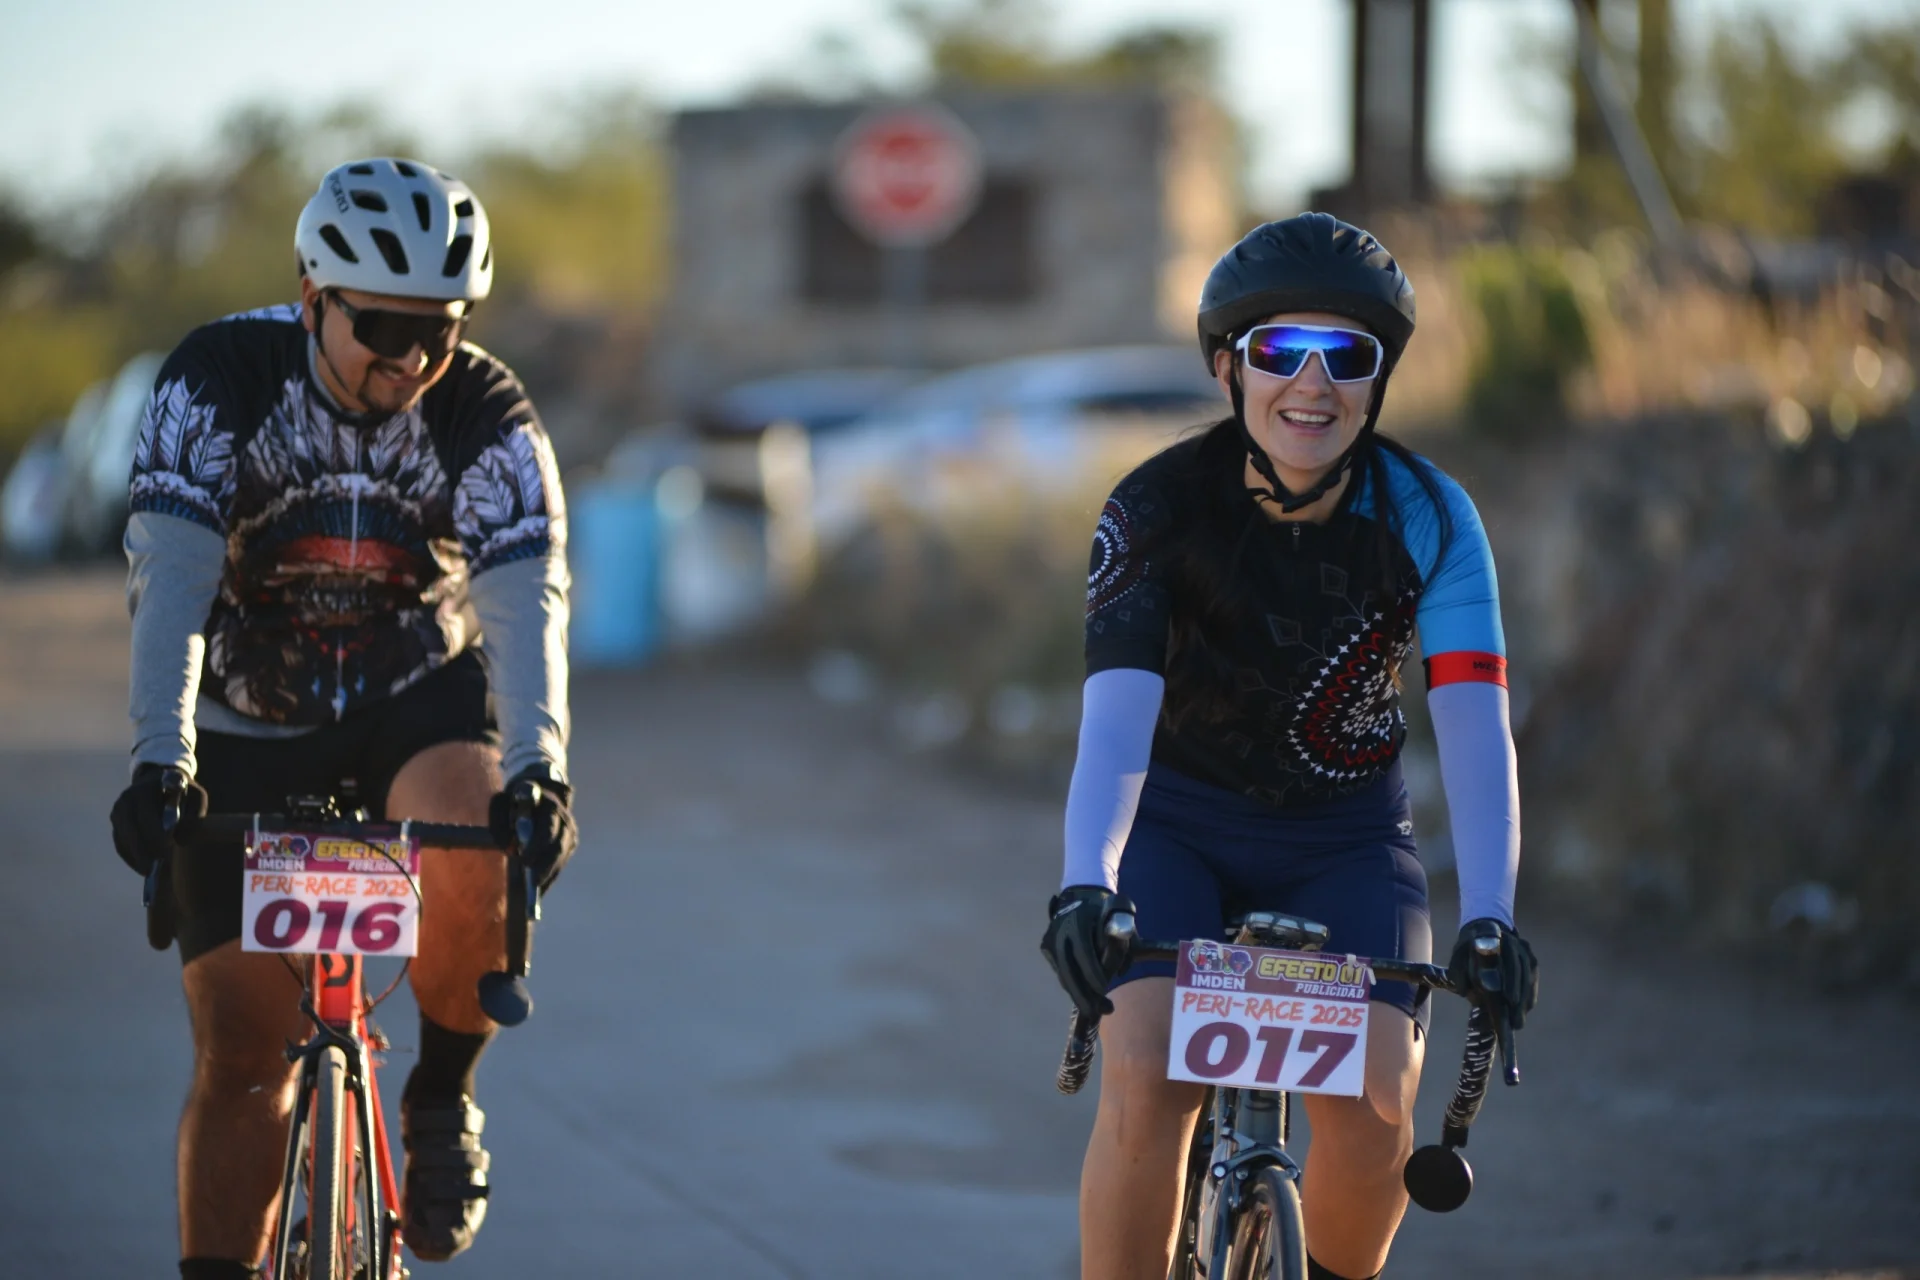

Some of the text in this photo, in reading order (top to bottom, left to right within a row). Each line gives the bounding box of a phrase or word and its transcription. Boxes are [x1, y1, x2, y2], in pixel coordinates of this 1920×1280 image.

[258, 858, 305, 871] IMDEN
[250, 873, 410, 896] PERI-RACE 2025
[254, 898, 406, 953] 016
[1259, 956, 1338, 982] EFECTO
[1191, 973, 1246, 990] IMDEN
[1295, 983, 1365, 999] PUBLICIDAD
[1181, 991, 1366, 1028] PERI-RACE 2025
[1184, 1021, 1358, 1088] 017
